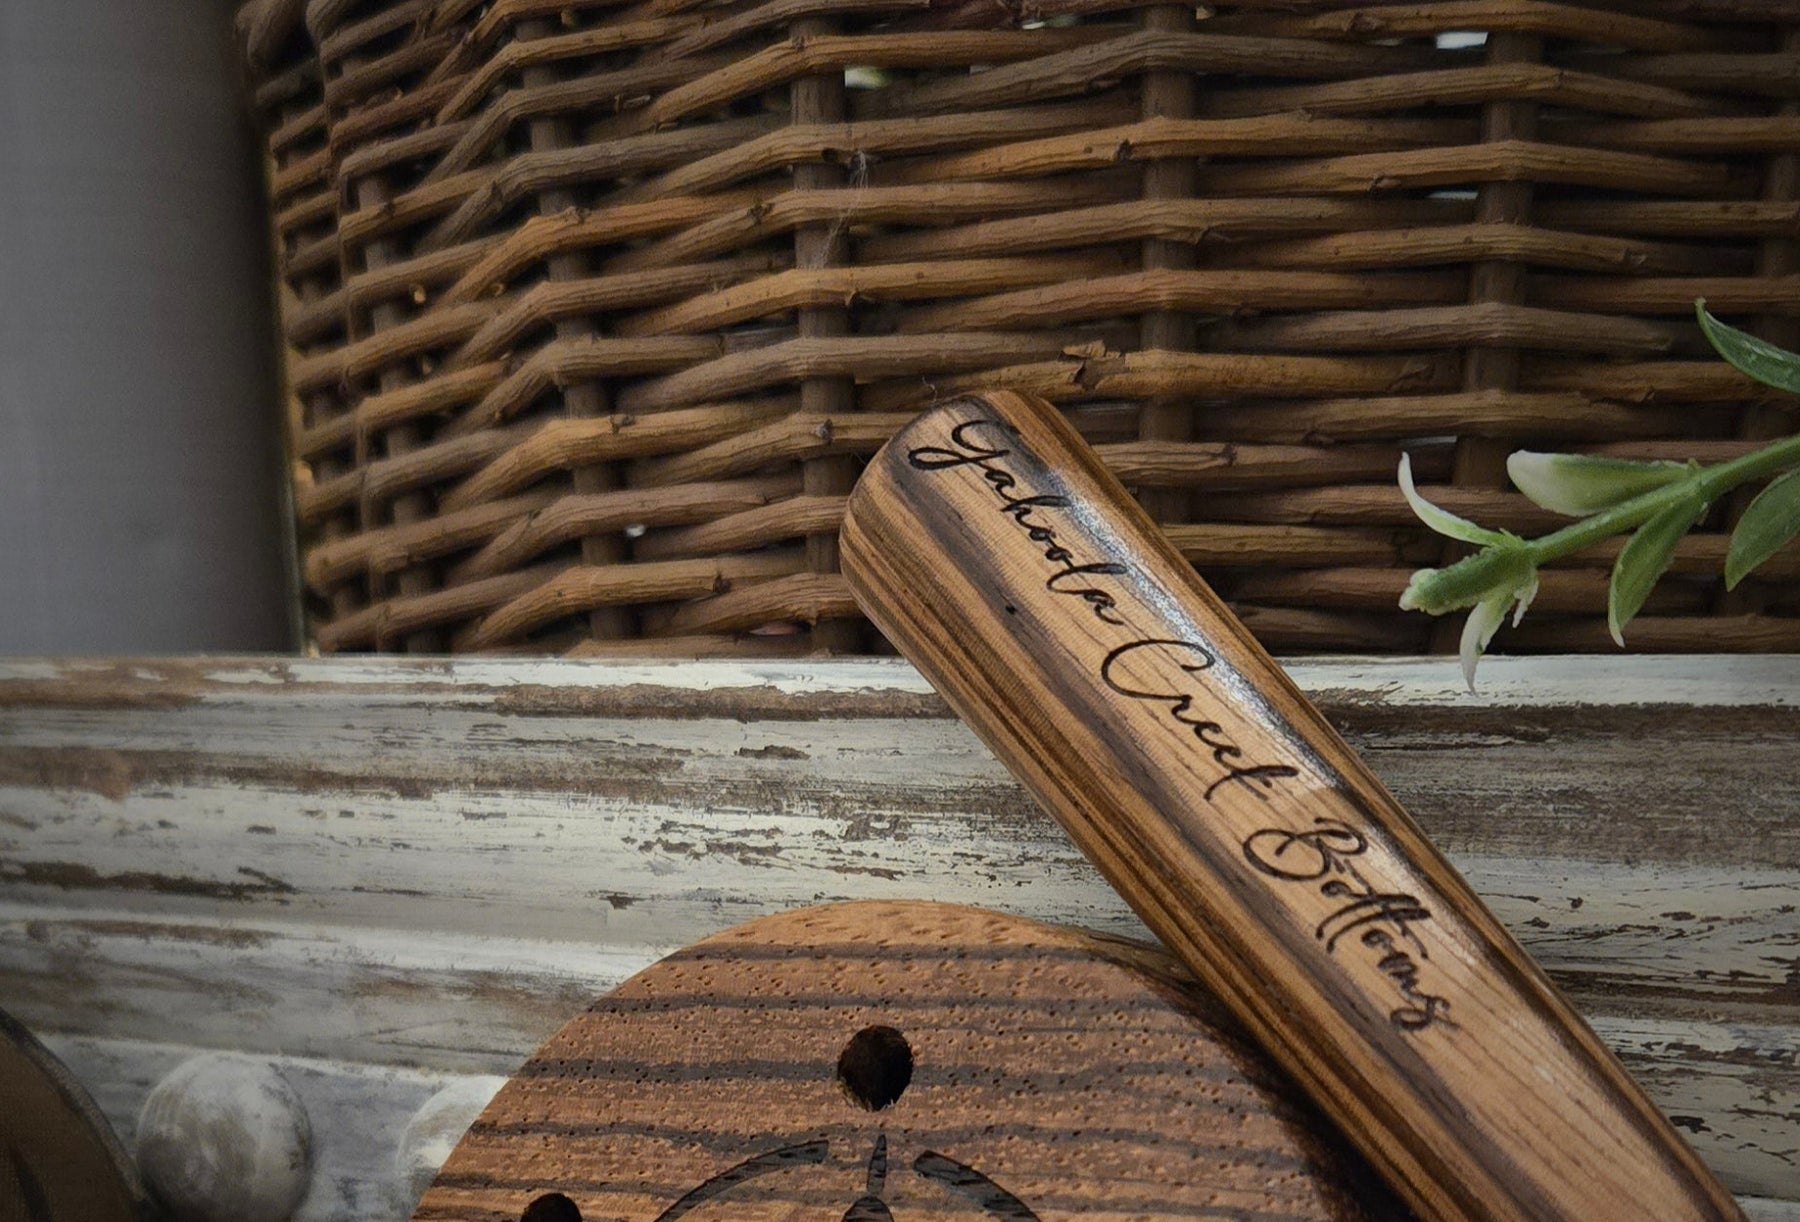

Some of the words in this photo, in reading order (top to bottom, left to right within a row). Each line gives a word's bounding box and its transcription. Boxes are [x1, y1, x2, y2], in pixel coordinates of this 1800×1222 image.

[908, 419, 1127, 625] Yahoola
[1100, 638, 1300, 802] Creek
[1242, 817, 1458, 1033] Bottoms
